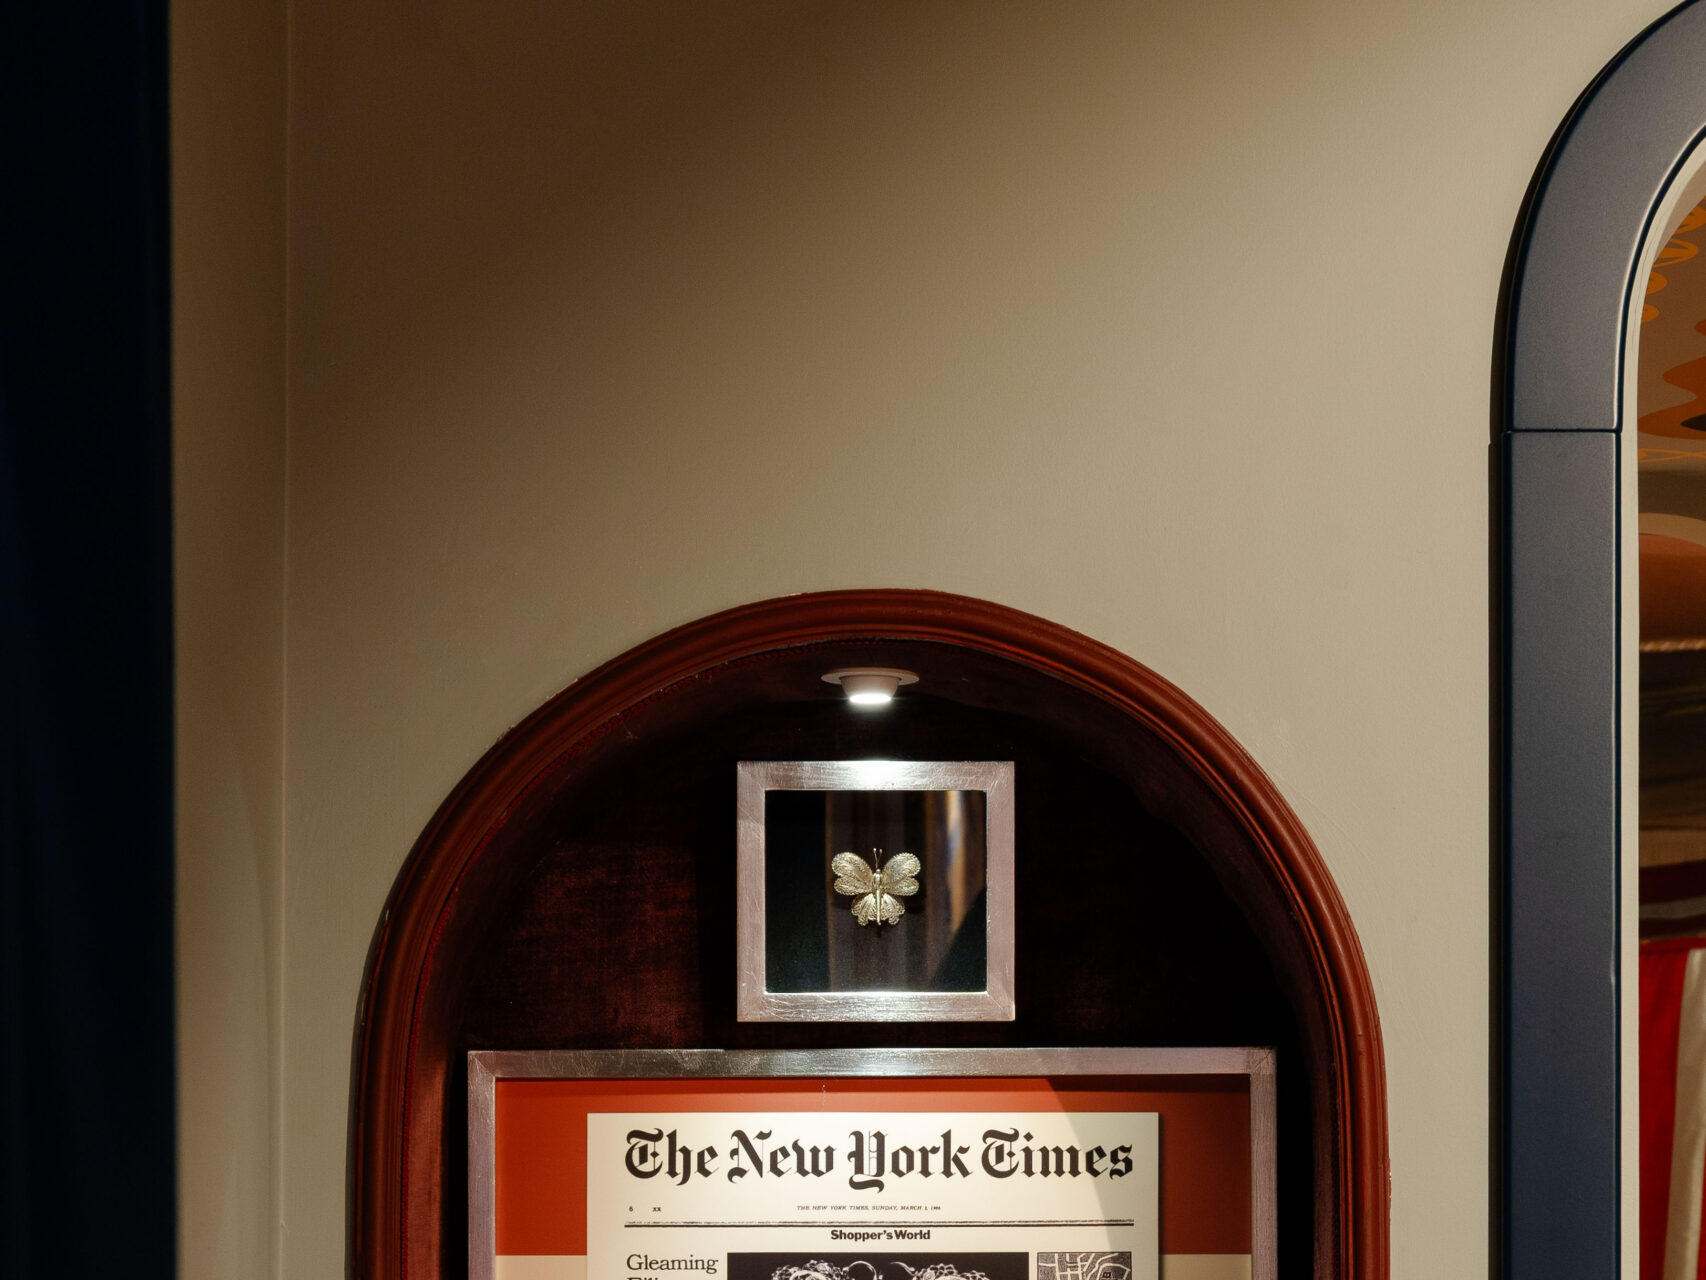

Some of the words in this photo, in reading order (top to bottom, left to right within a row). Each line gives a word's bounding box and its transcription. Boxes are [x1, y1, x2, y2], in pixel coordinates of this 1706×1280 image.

[625, 1128, 719, 1186] The
[727, 1129, 837, 1184] New
[848, 1128, 973, 1193] York
[981, 1128, 1133, 1180] Times
[830, 1229, 893, 1242] Shopper’s
[894, 1229, 930, 1240] World
[626, 1254, 718, 1274] Gleaming
